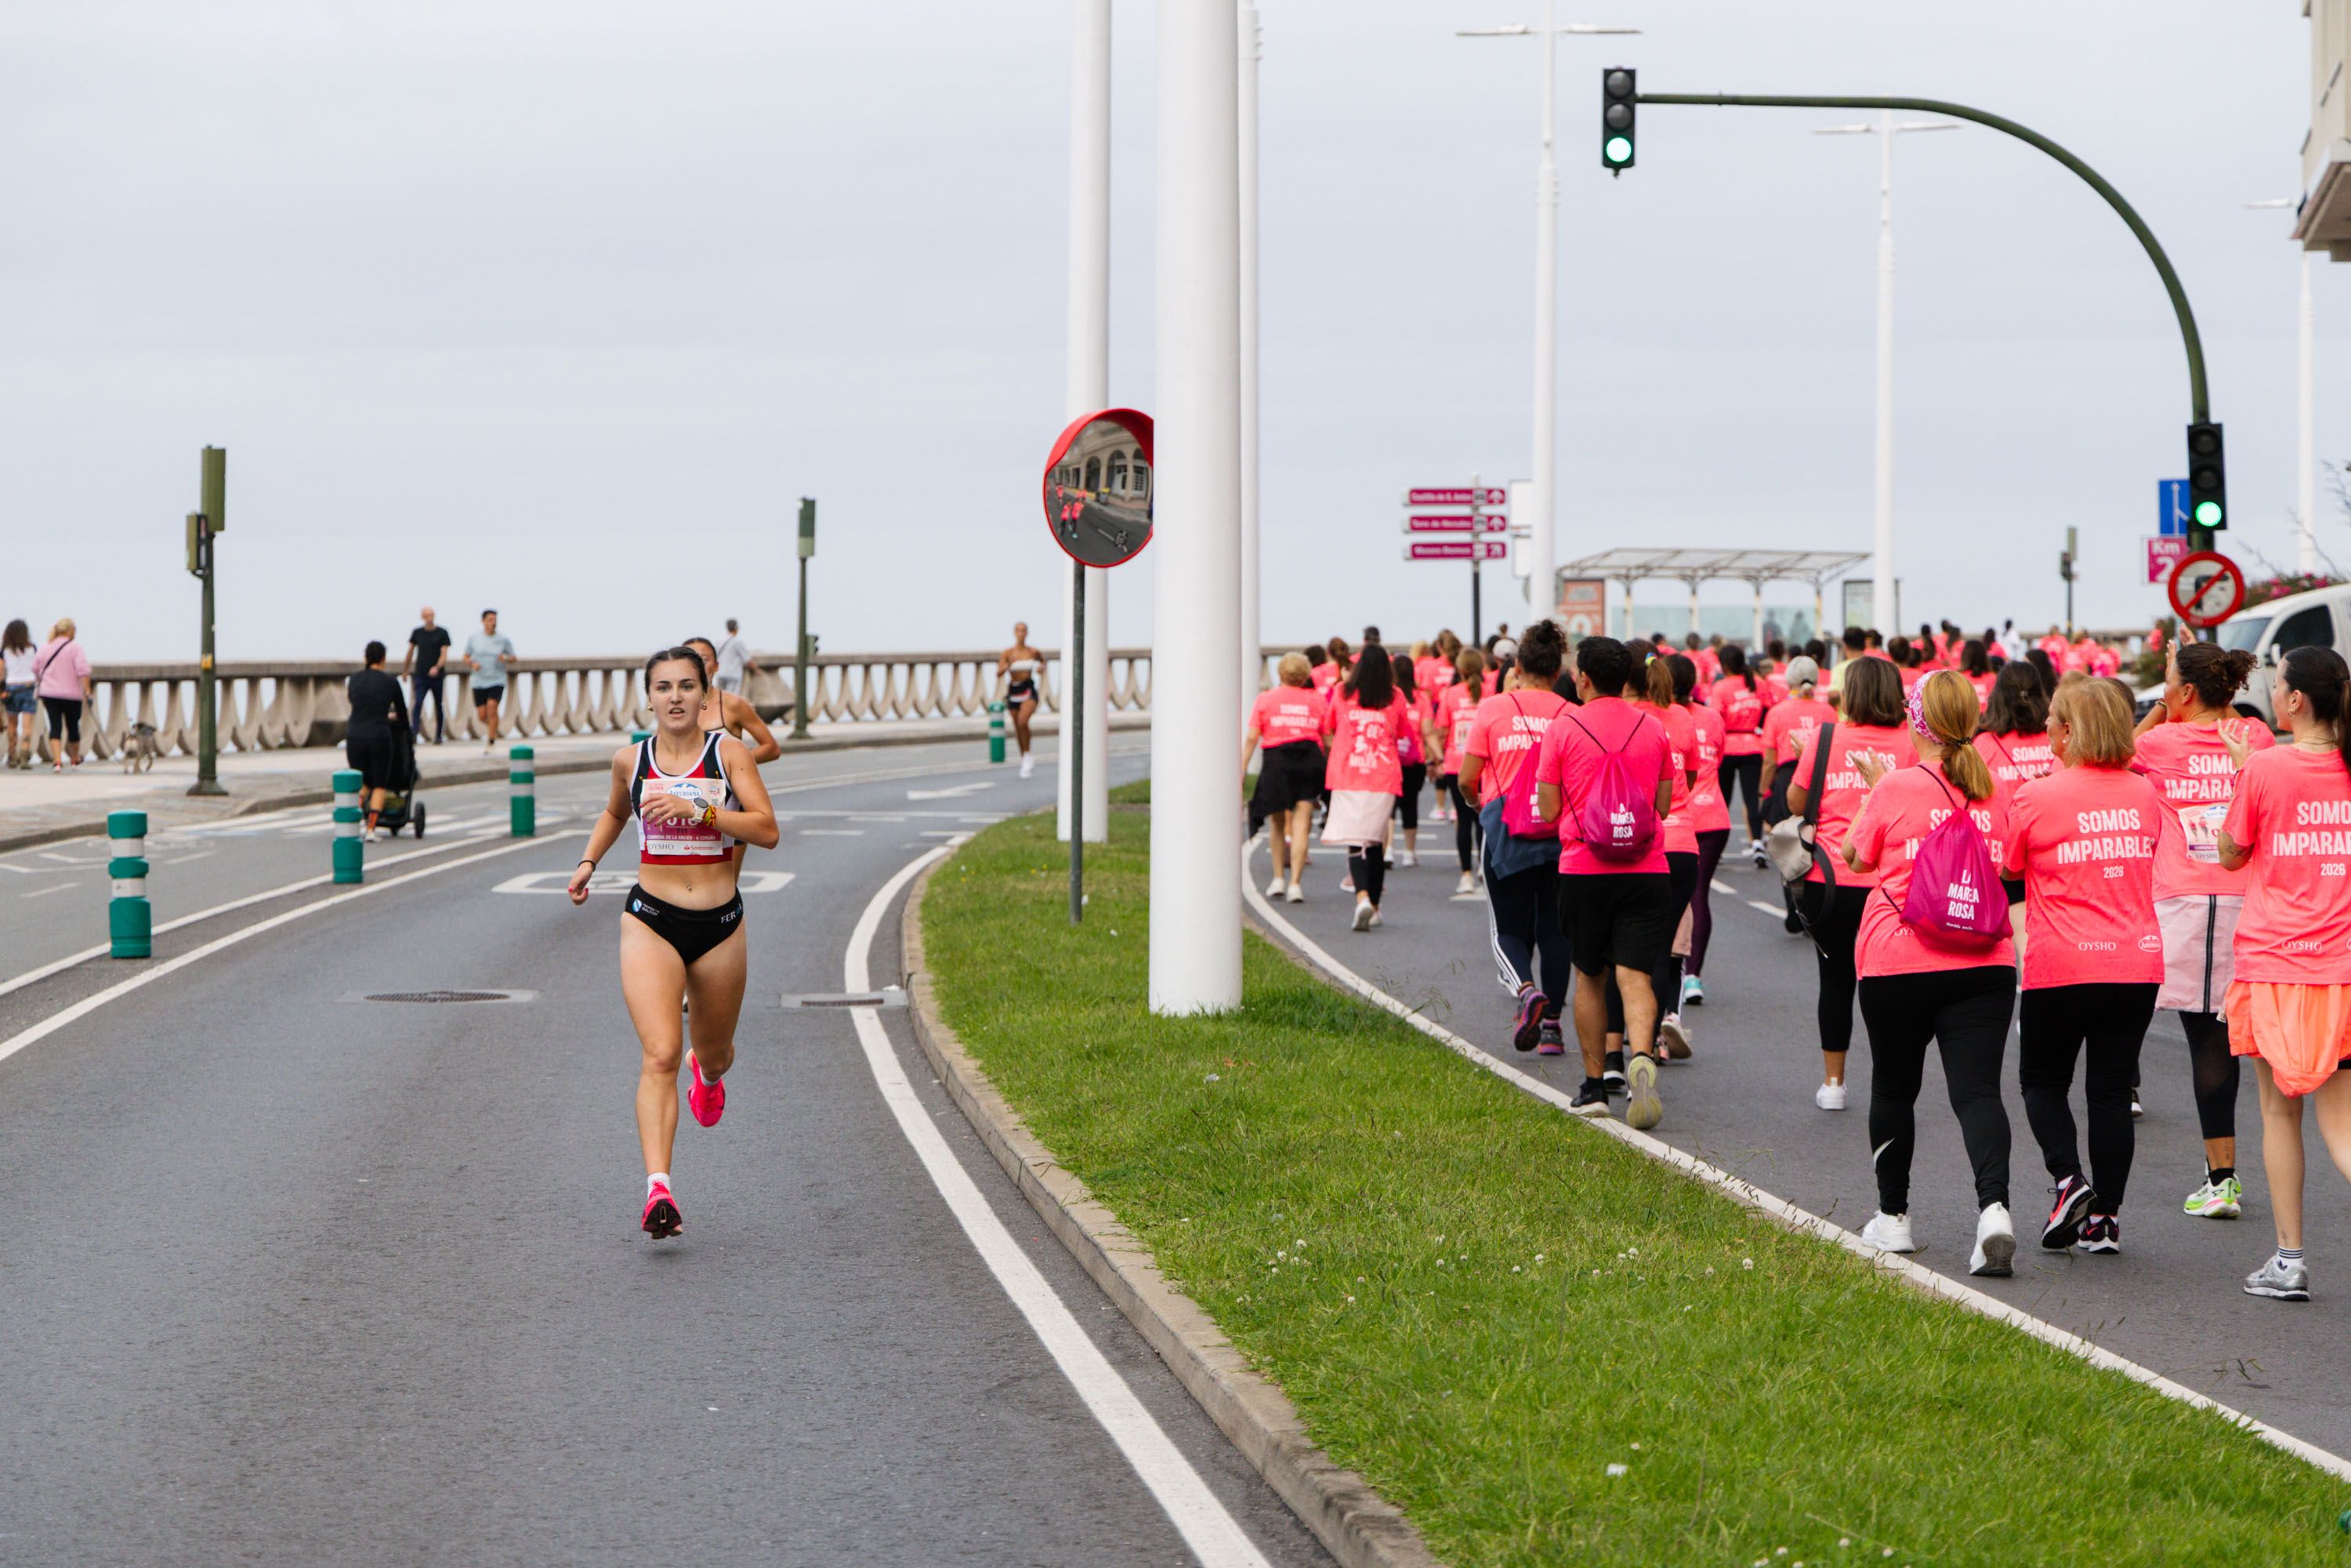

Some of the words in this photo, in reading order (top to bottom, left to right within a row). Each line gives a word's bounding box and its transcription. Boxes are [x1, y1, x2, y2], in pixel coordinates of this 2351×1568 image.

[2152, 541, 2180, 555] Km
[2157, 556, 2175, 582] 2
[1512, 715, 1552, 733] SOMO
[2165, 779, 2233, 798] IMPARA
[1610, 812, 1636, 825] MAREA
[1930, 809, 1991, 832] SOOS
[2078, 809, 2141, 834] SOMOS
[1613, 825, 1633, 838] ROSA
[2058, 836, 2155, 864] IMPARABLE
[2195, 852, 2220, 860] OYSH
[2320, 863, 2346, 876] 2026
[1947, 882, 1980, 904] MAREA
[1947, 900, 1975, 921] ROSA
[2078, 941, 2117, 951] OYSHO
[2282, 940, 2323, 951] OYSHO
